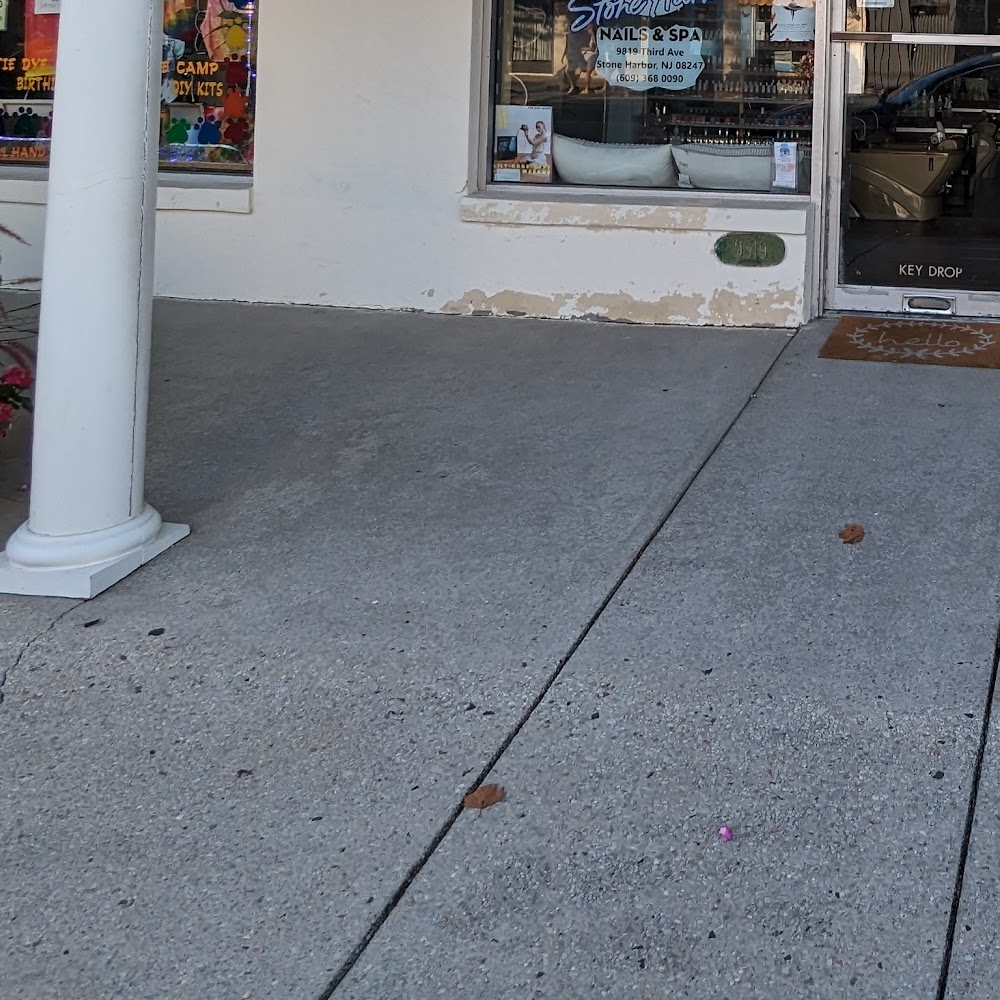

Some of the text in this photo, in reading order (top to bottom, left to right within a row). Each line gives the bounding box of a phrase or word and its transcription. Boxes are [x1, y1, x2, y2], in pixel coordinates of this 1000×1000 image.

[600, 28, 701, 41] NAILS & SPA
[616, 47, 685, 57] 9819 Third Ave
[176, 60, 219, 76] CAMP
[596, 60, 703, 71] Stone Harbor, NJ 08247
[616, 73, 684, 83] (609) 368 0090
[173, 80, 193, 96] DIY
[197, 81, 224, 97] KITS
[899, 264, 963, 279] KEY DROP
[878, 331, 960, 347] hello
